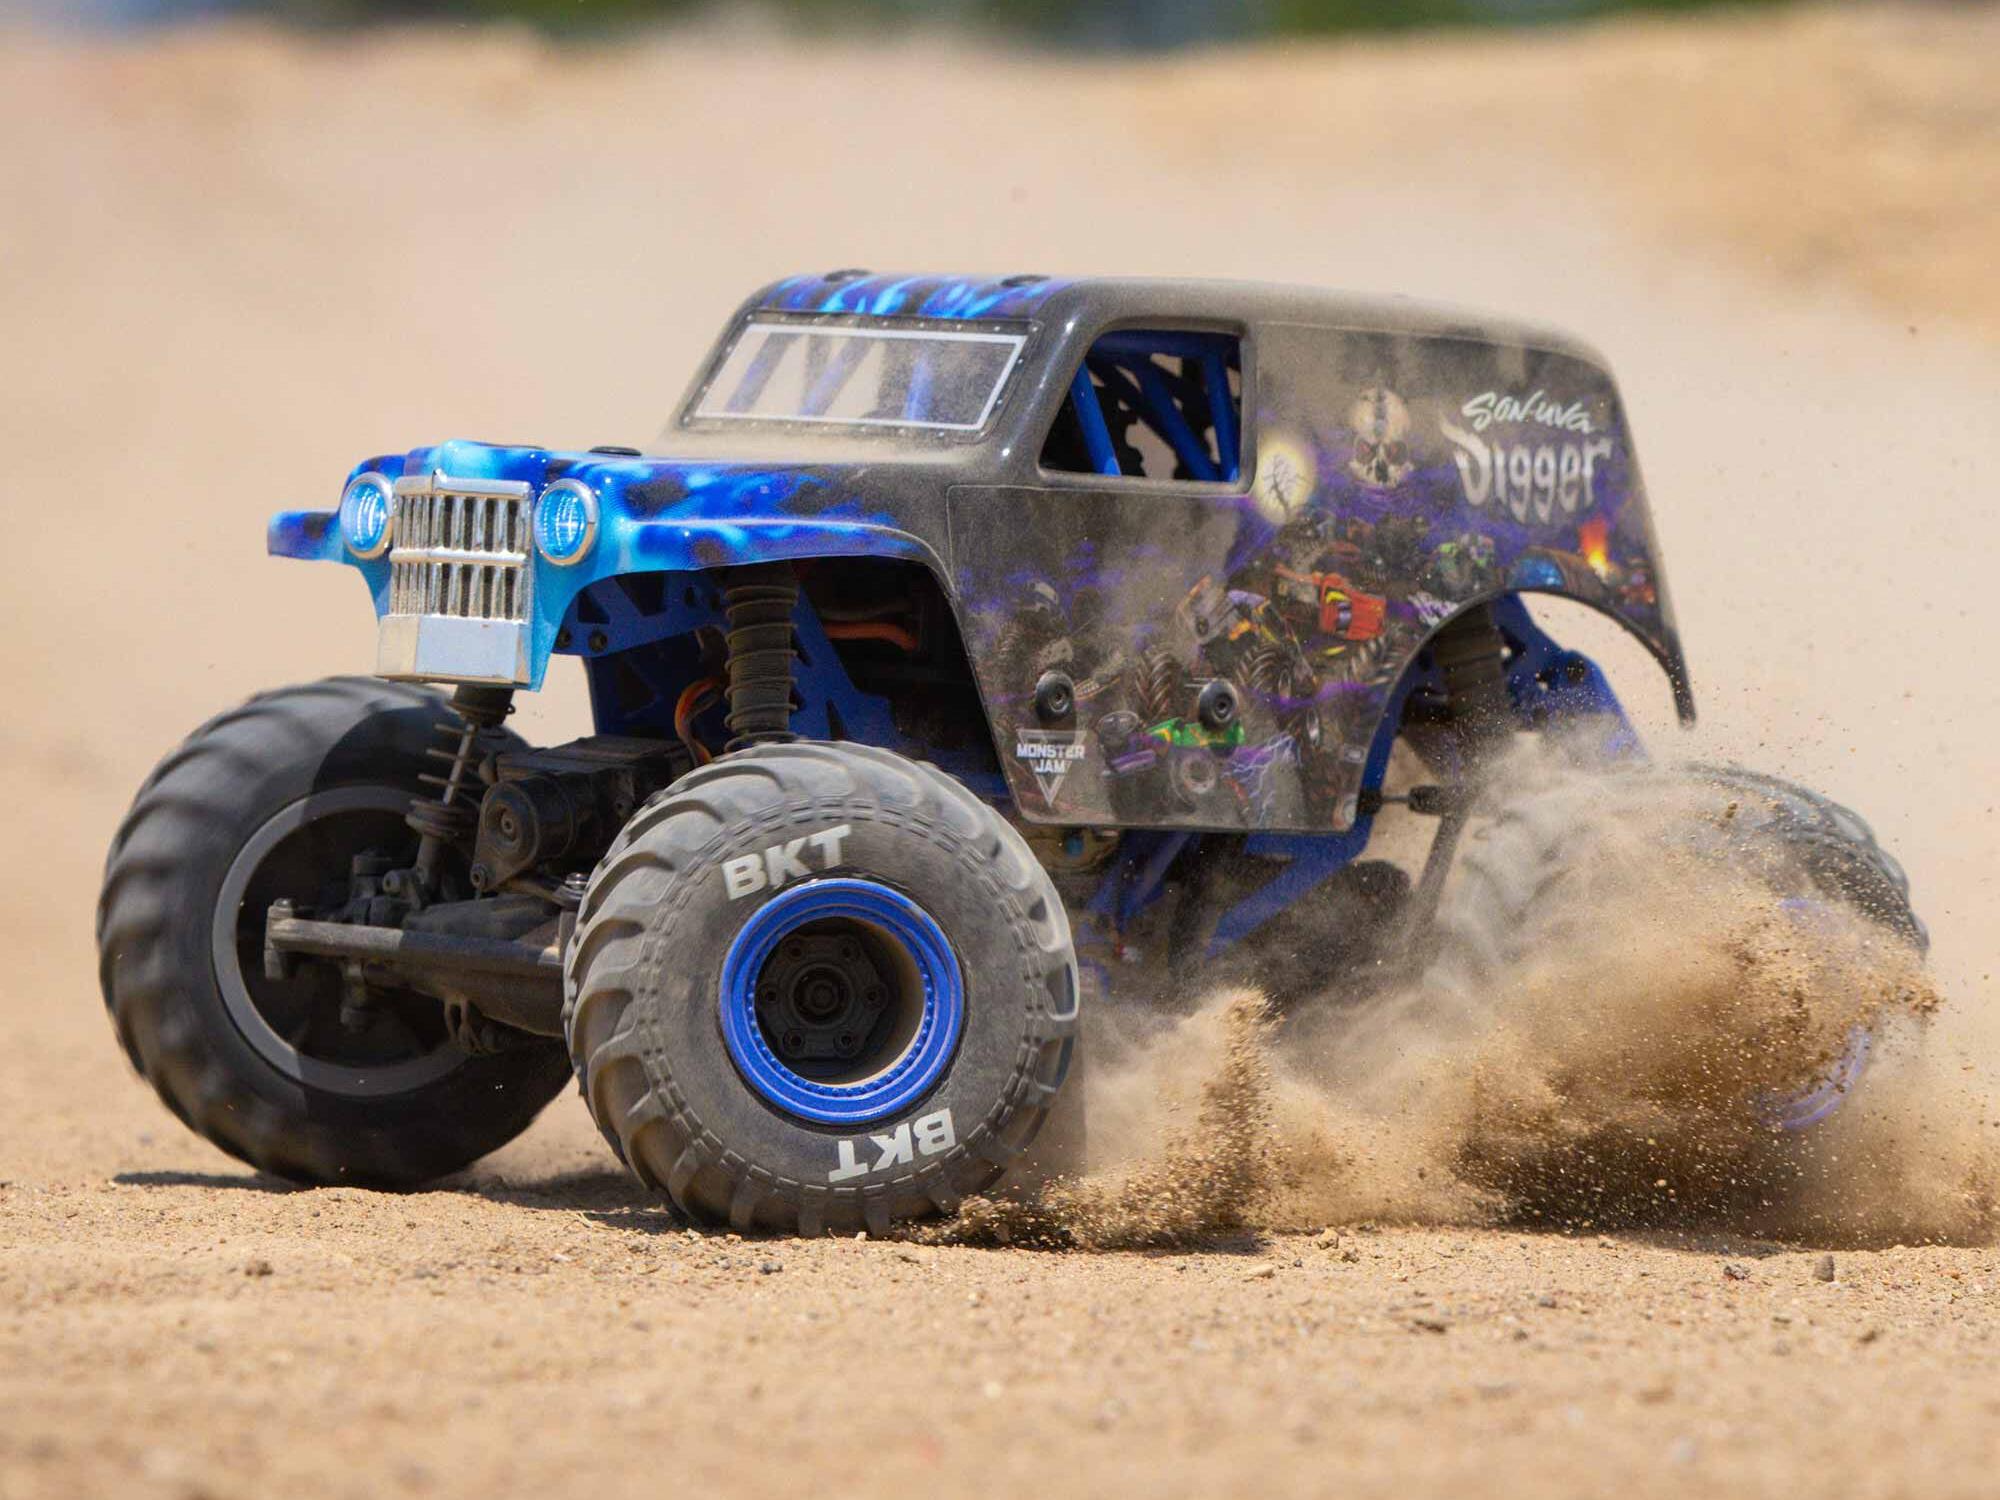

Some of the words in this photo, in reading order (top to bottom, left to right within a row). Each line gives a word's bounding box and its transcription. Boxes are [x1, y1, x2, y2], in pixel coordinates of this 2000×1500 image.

[1016, 744, 1085, 758] MONSTER
[1034, 759, 1065, 773] JAM
[722, 825, 852, 900] BKT
[828, 1108, 957, 1183] BKT
